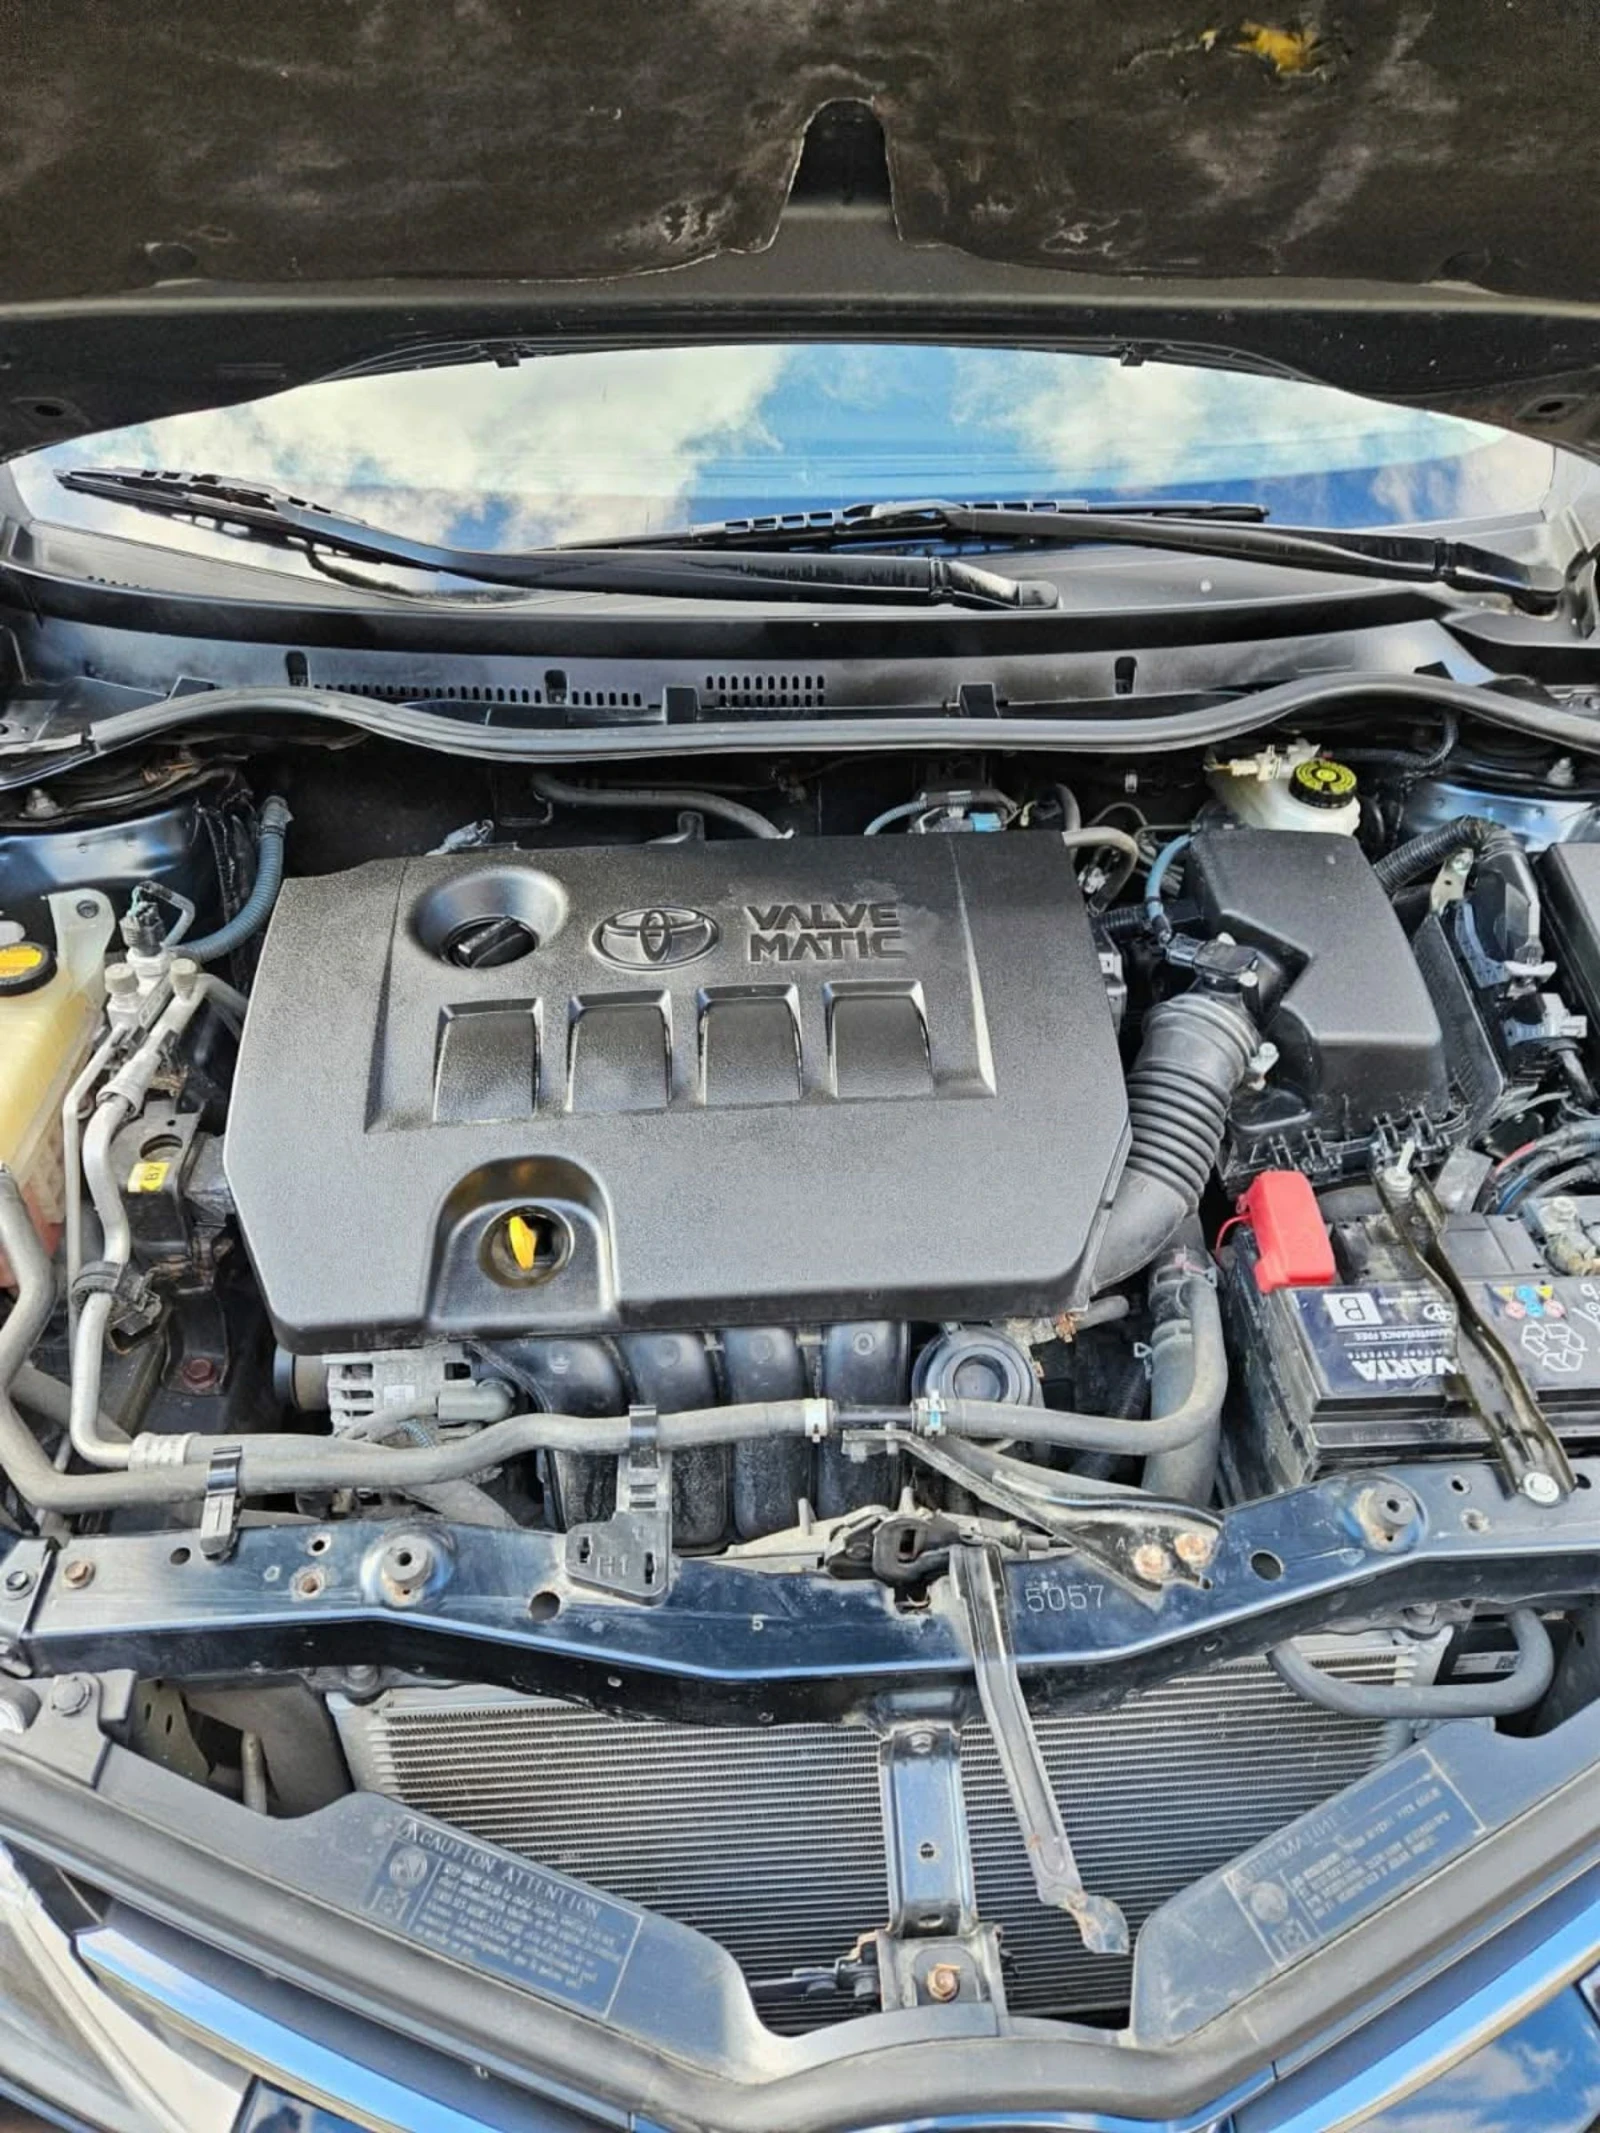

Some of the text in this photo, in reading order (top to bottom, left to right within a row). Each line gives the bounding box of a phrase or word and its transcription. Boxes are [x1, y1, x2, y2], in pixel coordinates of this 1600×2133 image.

[747, 903, 899, 930] VALVE
[749, 931, 907, 961] MATIC
[1339, 1297, 1366, 1321] B
[1351, 1357, 1457, 1382] VARTA
[1024, 1584, 1104, 1613] 5057
[419, 1832, 600, 1920] CAUTION ATTENTION
